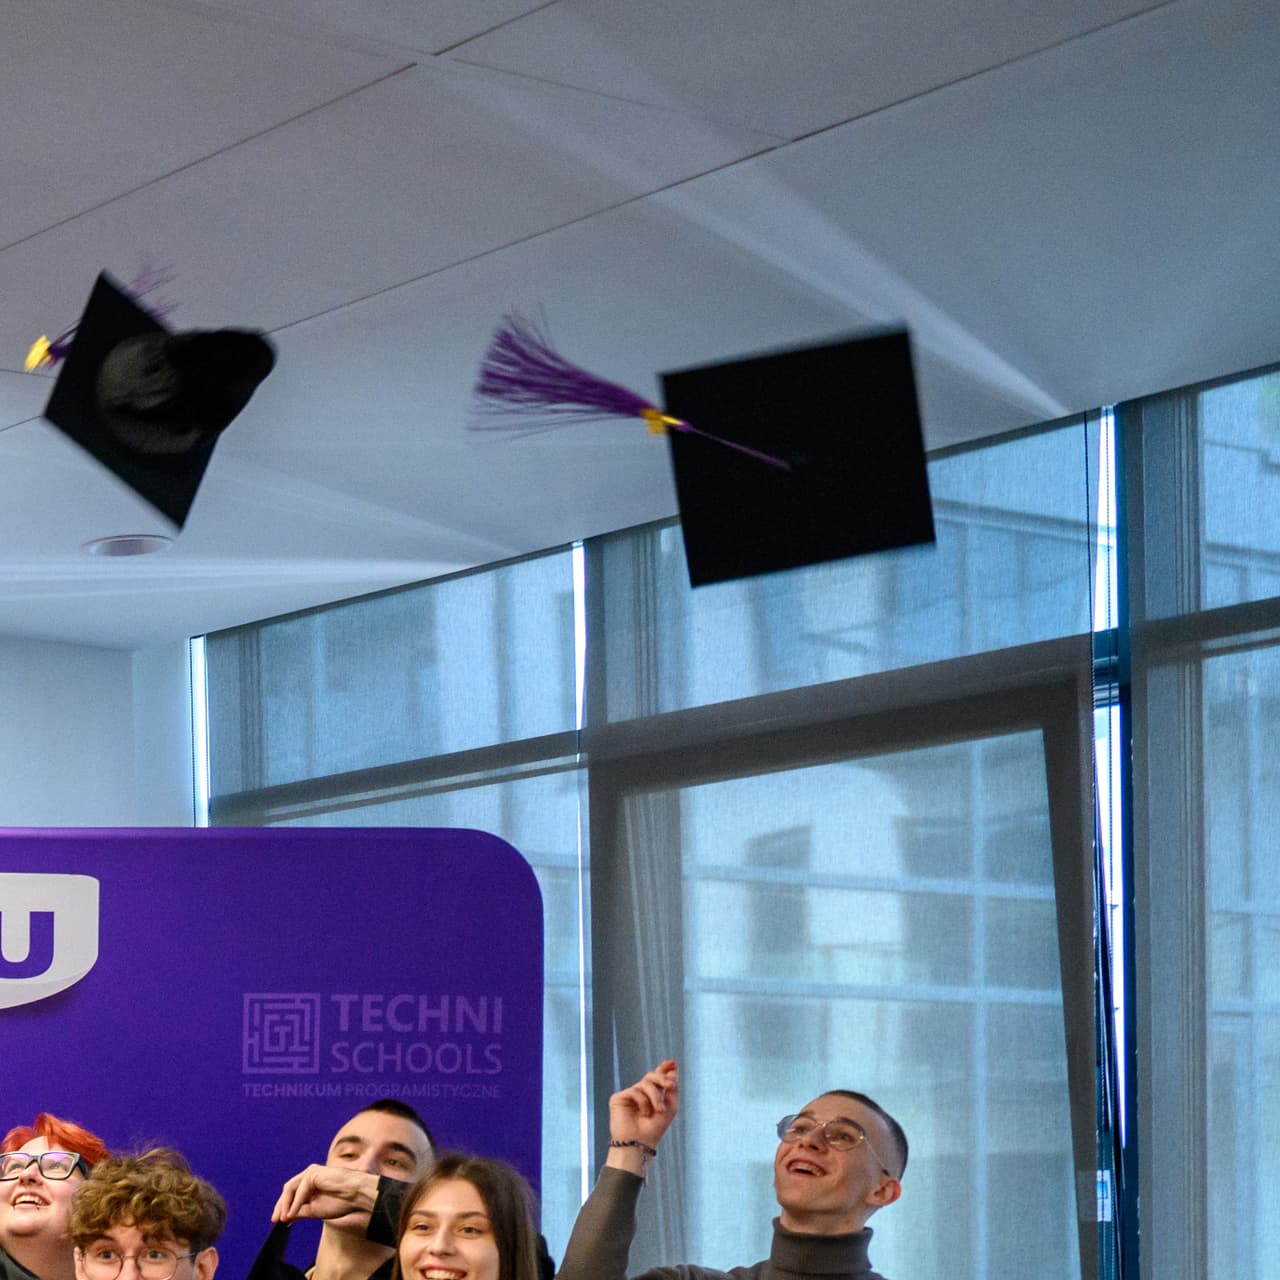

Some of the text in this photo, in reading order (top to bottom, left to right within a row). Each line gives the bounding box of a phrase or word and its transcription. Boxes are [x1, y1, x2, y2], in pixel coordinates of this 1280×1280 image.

[330, 994, 503, 1033] TECHNI
[329, 1041, 503, 1074] SCHOOLS
[242, 1082, 500, 1098] TECHNIKUM PROGRAMISTYCZNE
